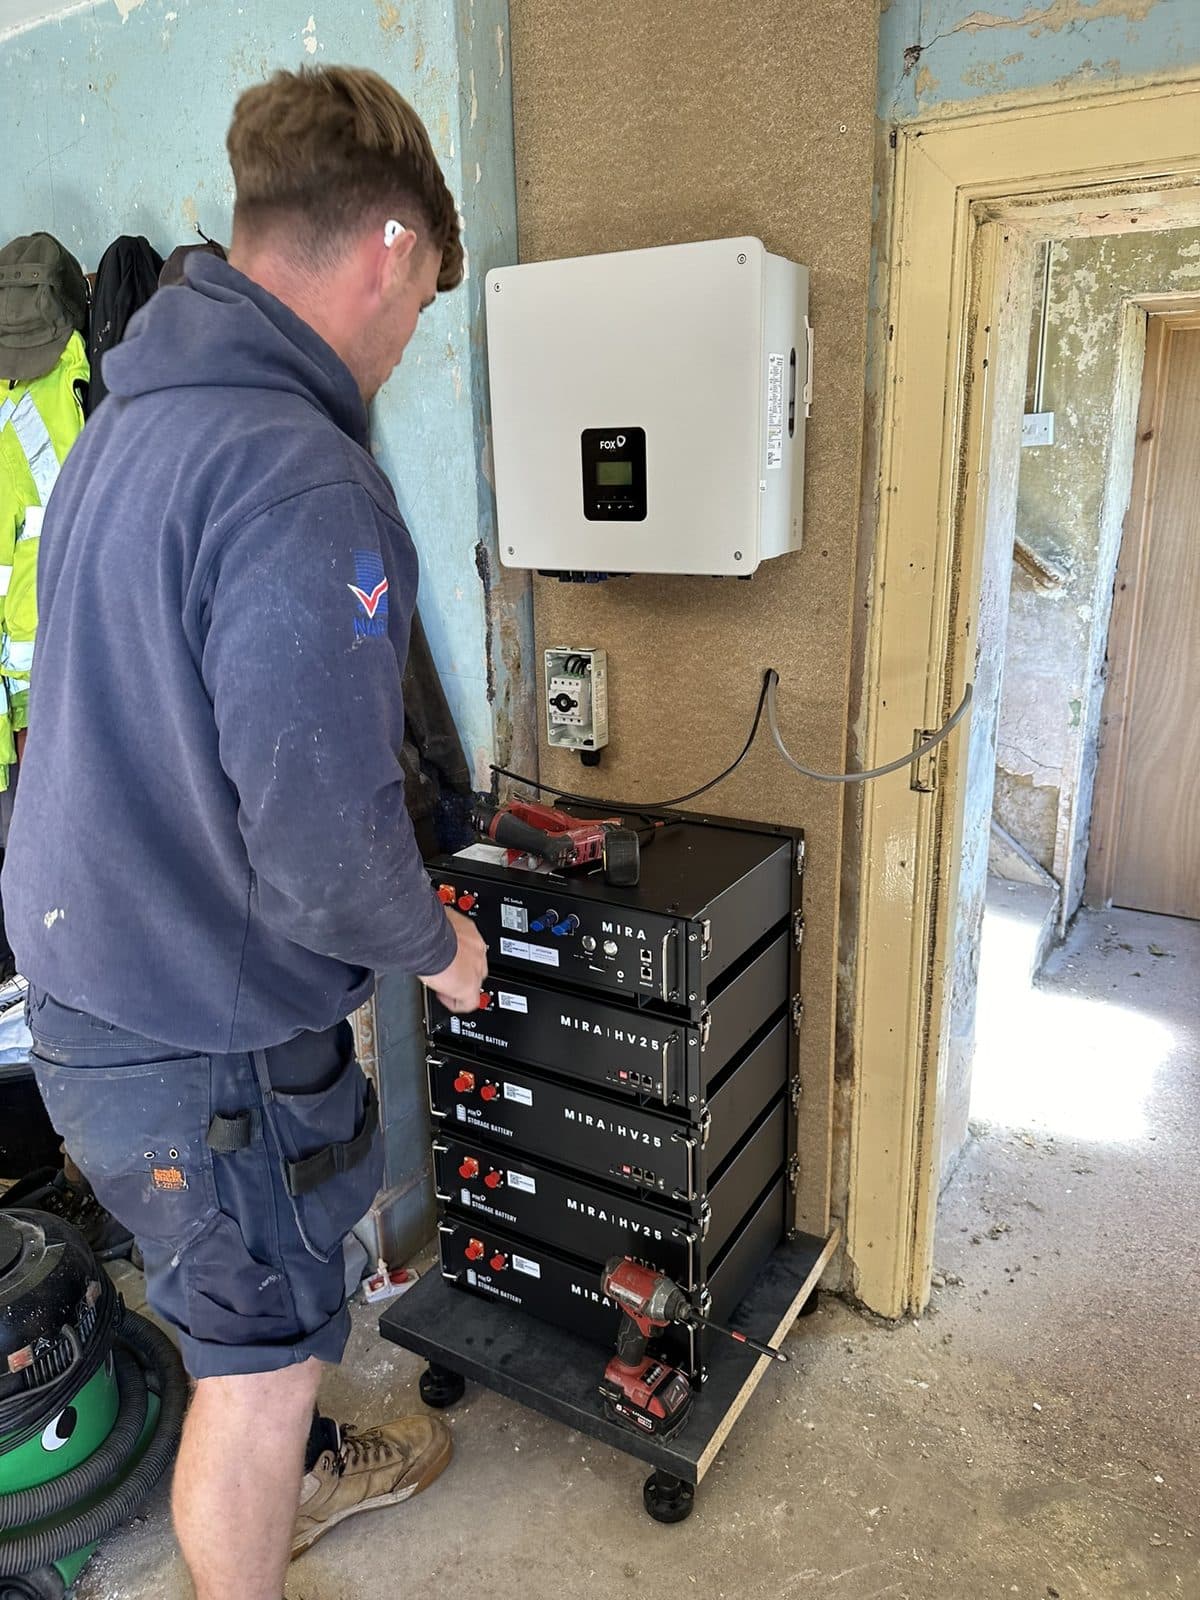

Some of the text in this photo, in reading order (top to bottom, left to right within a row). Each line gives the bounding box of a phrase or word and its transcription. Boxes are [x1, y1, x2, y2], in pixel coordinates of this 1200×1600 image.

[600, 440, 616, 450] FOX
[601, 921, 647, 941] MIRA
[461, 1028, 509, 1048] STORAGE BATTERY
[560, 1015, 660, 1051] MIRA HV25
[467, 1116, 514, 1137] STORAGE BATTERY
[564, 1108, 662, 1147] MIRA HV25
[471, 1201, 517, 1223] STORAGE BATTERY
[567, 1198, 662, 1240] MIRA HV25
[477, 1281, 522, 1304] STORAGE BATTERY
[571, 1283, 611, 1307] MIRA
